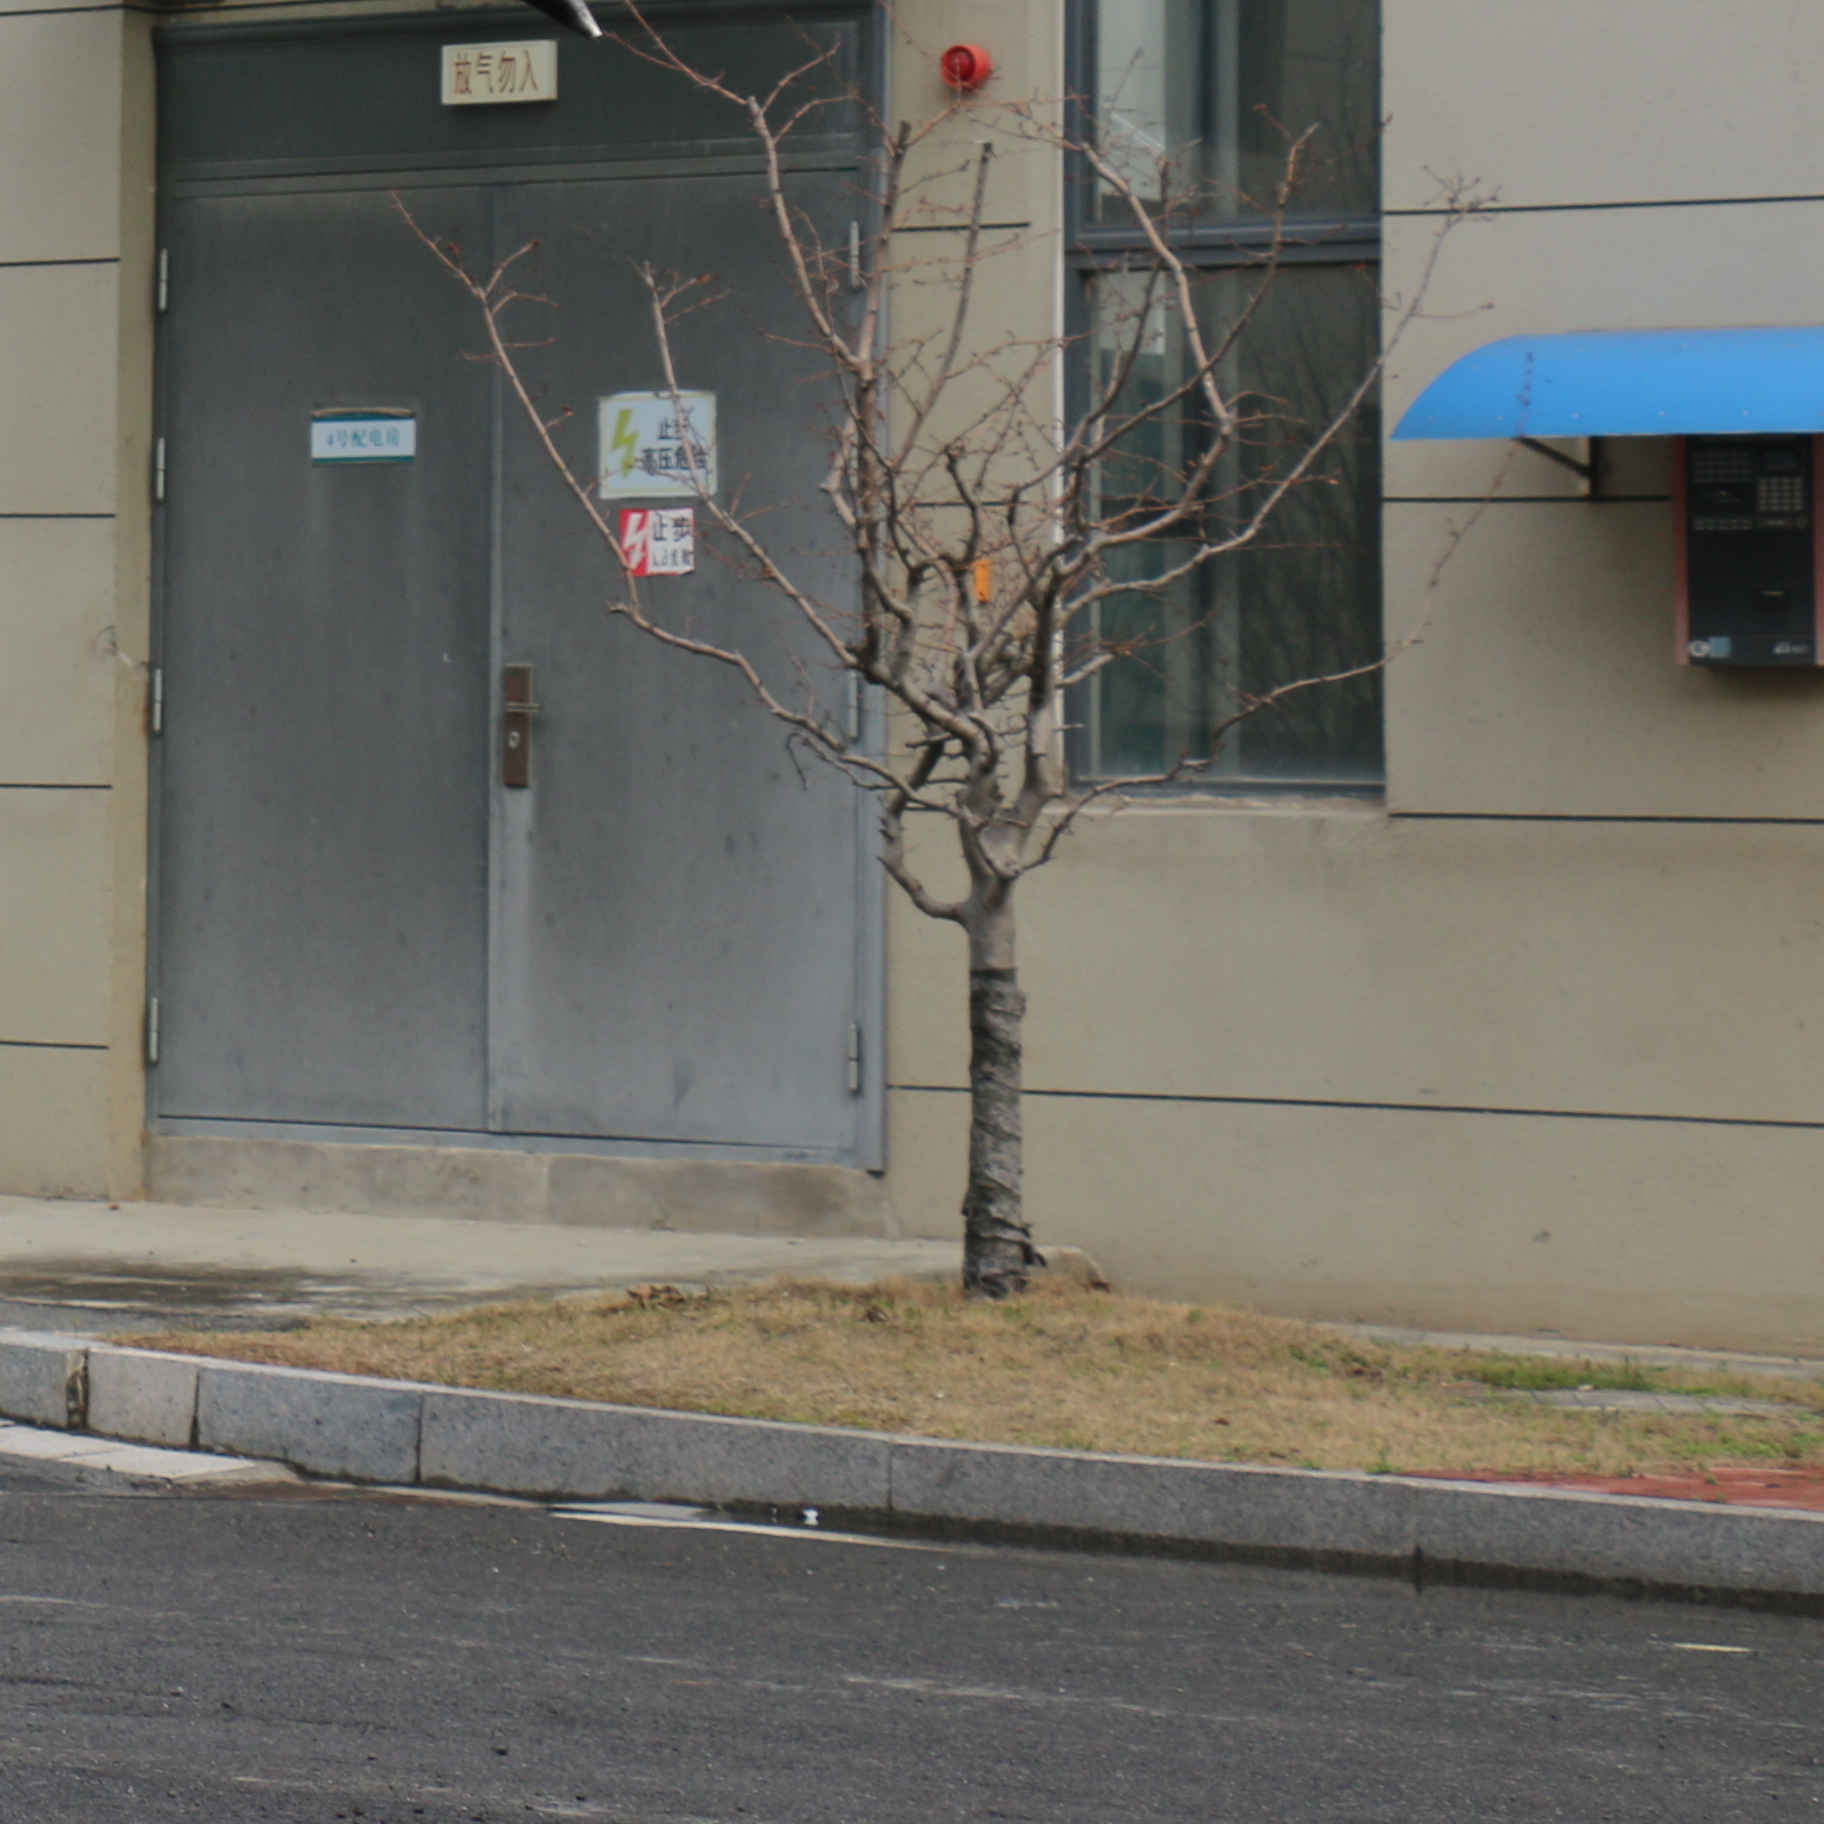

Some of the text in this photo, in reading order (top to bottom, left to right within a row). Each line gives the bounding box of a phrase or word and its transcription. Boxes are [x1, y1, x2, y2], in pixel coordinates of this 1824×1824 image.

[453, 49, 539, 95] 放气勿入
[653, 515, 692, 543] 止步
